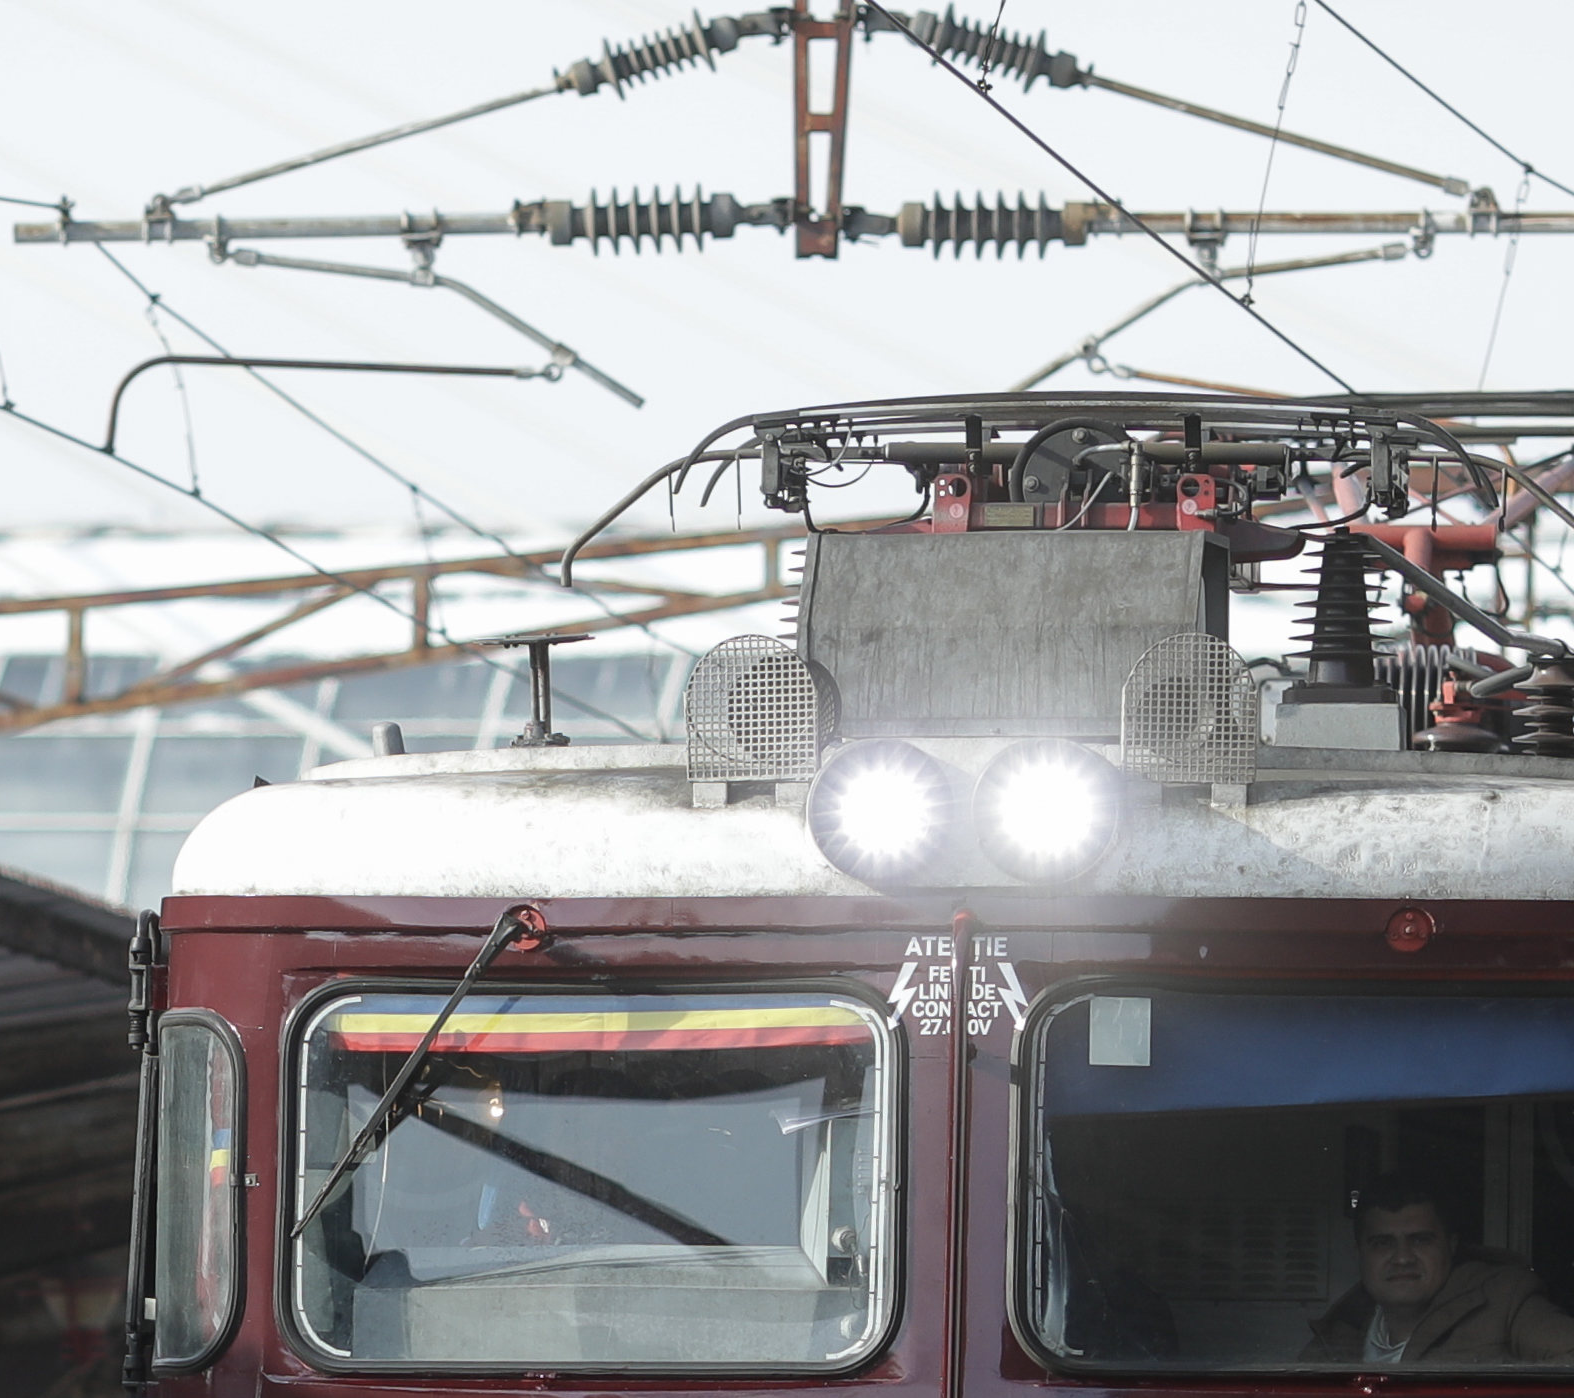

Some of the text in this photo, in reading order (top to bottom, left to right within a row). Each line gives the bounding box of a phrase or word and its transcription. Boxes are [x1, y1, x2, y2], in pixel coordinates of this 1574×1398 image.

[904, 936, 1008, 962] ATEȚIE
[972, 984, 996, 1001] DE
[911, 1001, 1003, 1019] CONACT
[919, 1019, 993, 1036] 27.0V
